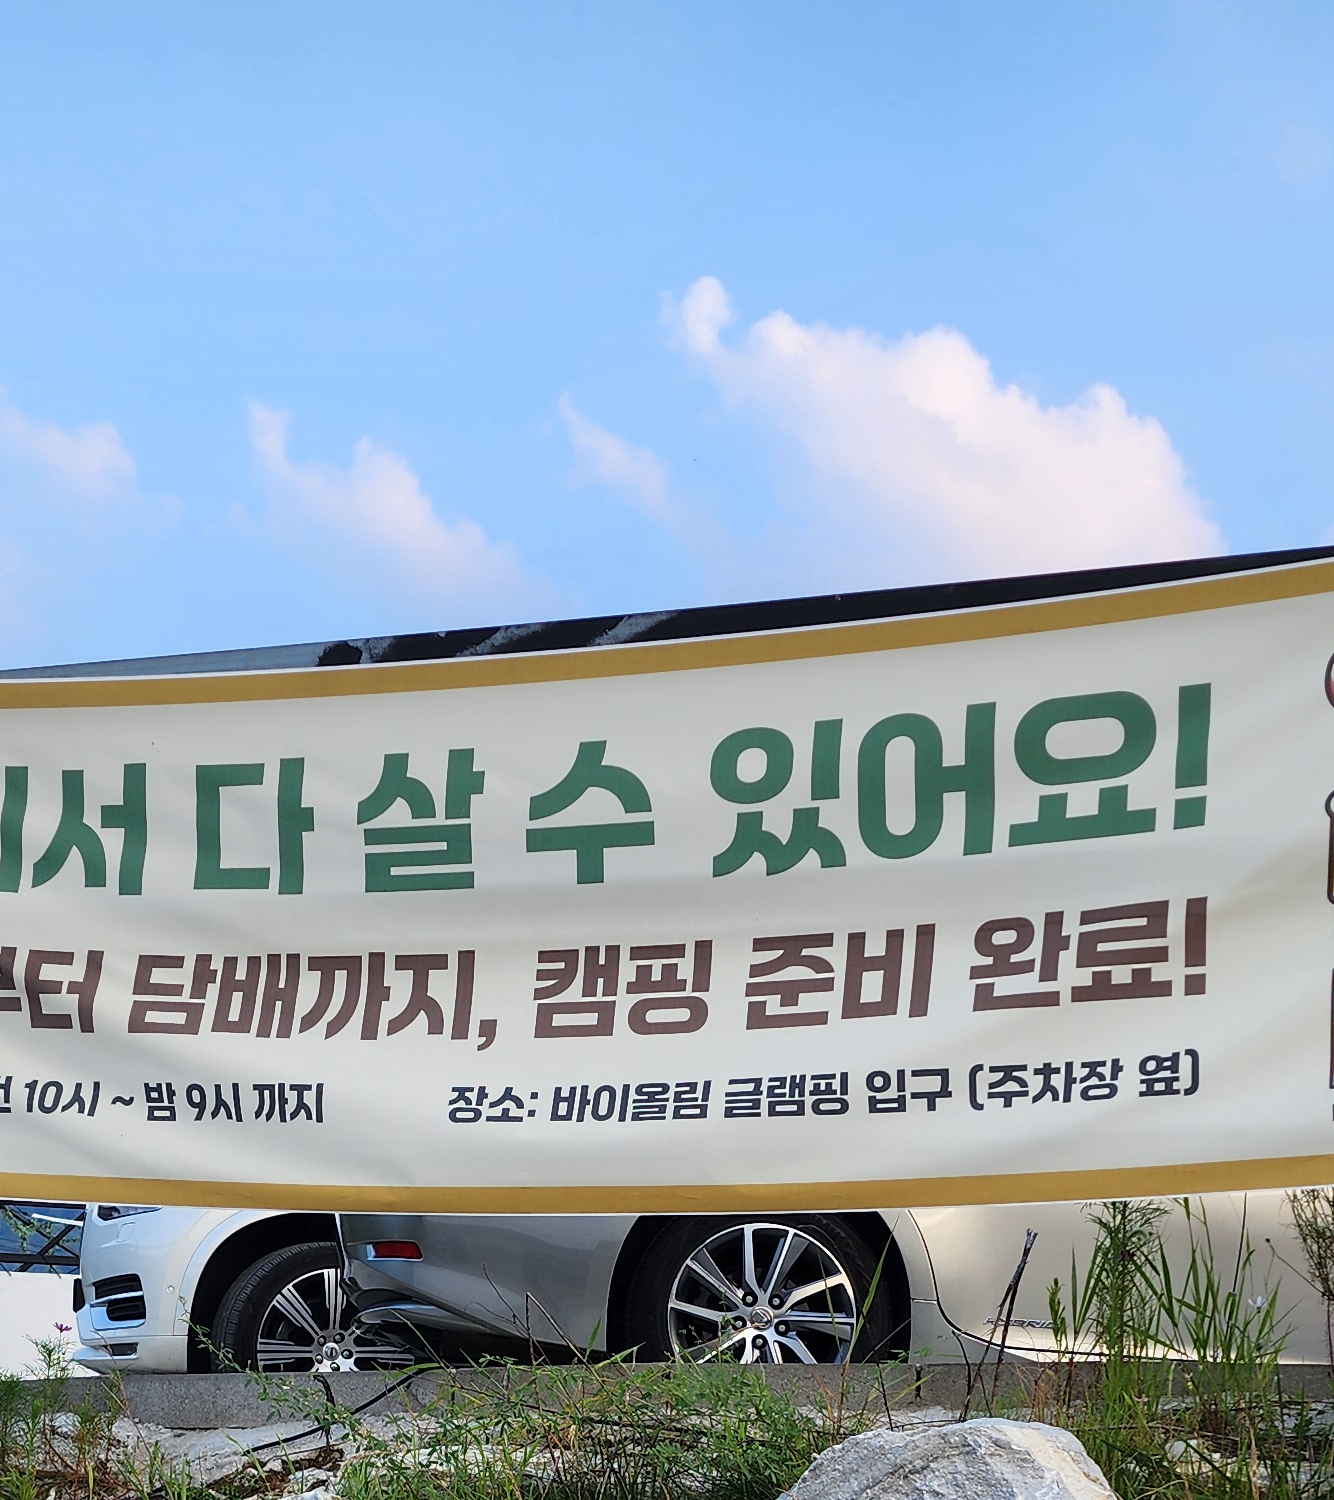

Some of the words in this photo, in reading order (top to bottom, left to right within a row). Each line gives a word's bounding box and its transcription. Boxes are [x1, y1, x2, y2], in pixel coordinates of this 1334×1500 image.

[192, 756, 315, 896] 다
[356, 747, 486, 894] 살
[525, 739, 656, 885] 수
[709, 682, 1212, 879] 있어요!
[127, 950, 498, 1052] 담배까지,
[532, 938, 714, 1040] 캠핑
[744, 923, 937, 1031] 준비
[968, 895, 1209, 1013] 완료!
[23, 1079, 101, 1118] 10시
[143, 1082, 177, 1122] 밤
[185, 1082, 244, 1123] 9시
[252, 1082, 325, 1124] 까지
[447, 1085, 538, 1124] 장소:
[549, 1080, 709, 1123] 바이올림
[723, 1072, 850, 1119] 글램핑
[865, 1067, 954, 1113] 입구
[968, 1056, 1120, 1112] (주차장
[1138, 1048, 1200, 1098] 옆)
